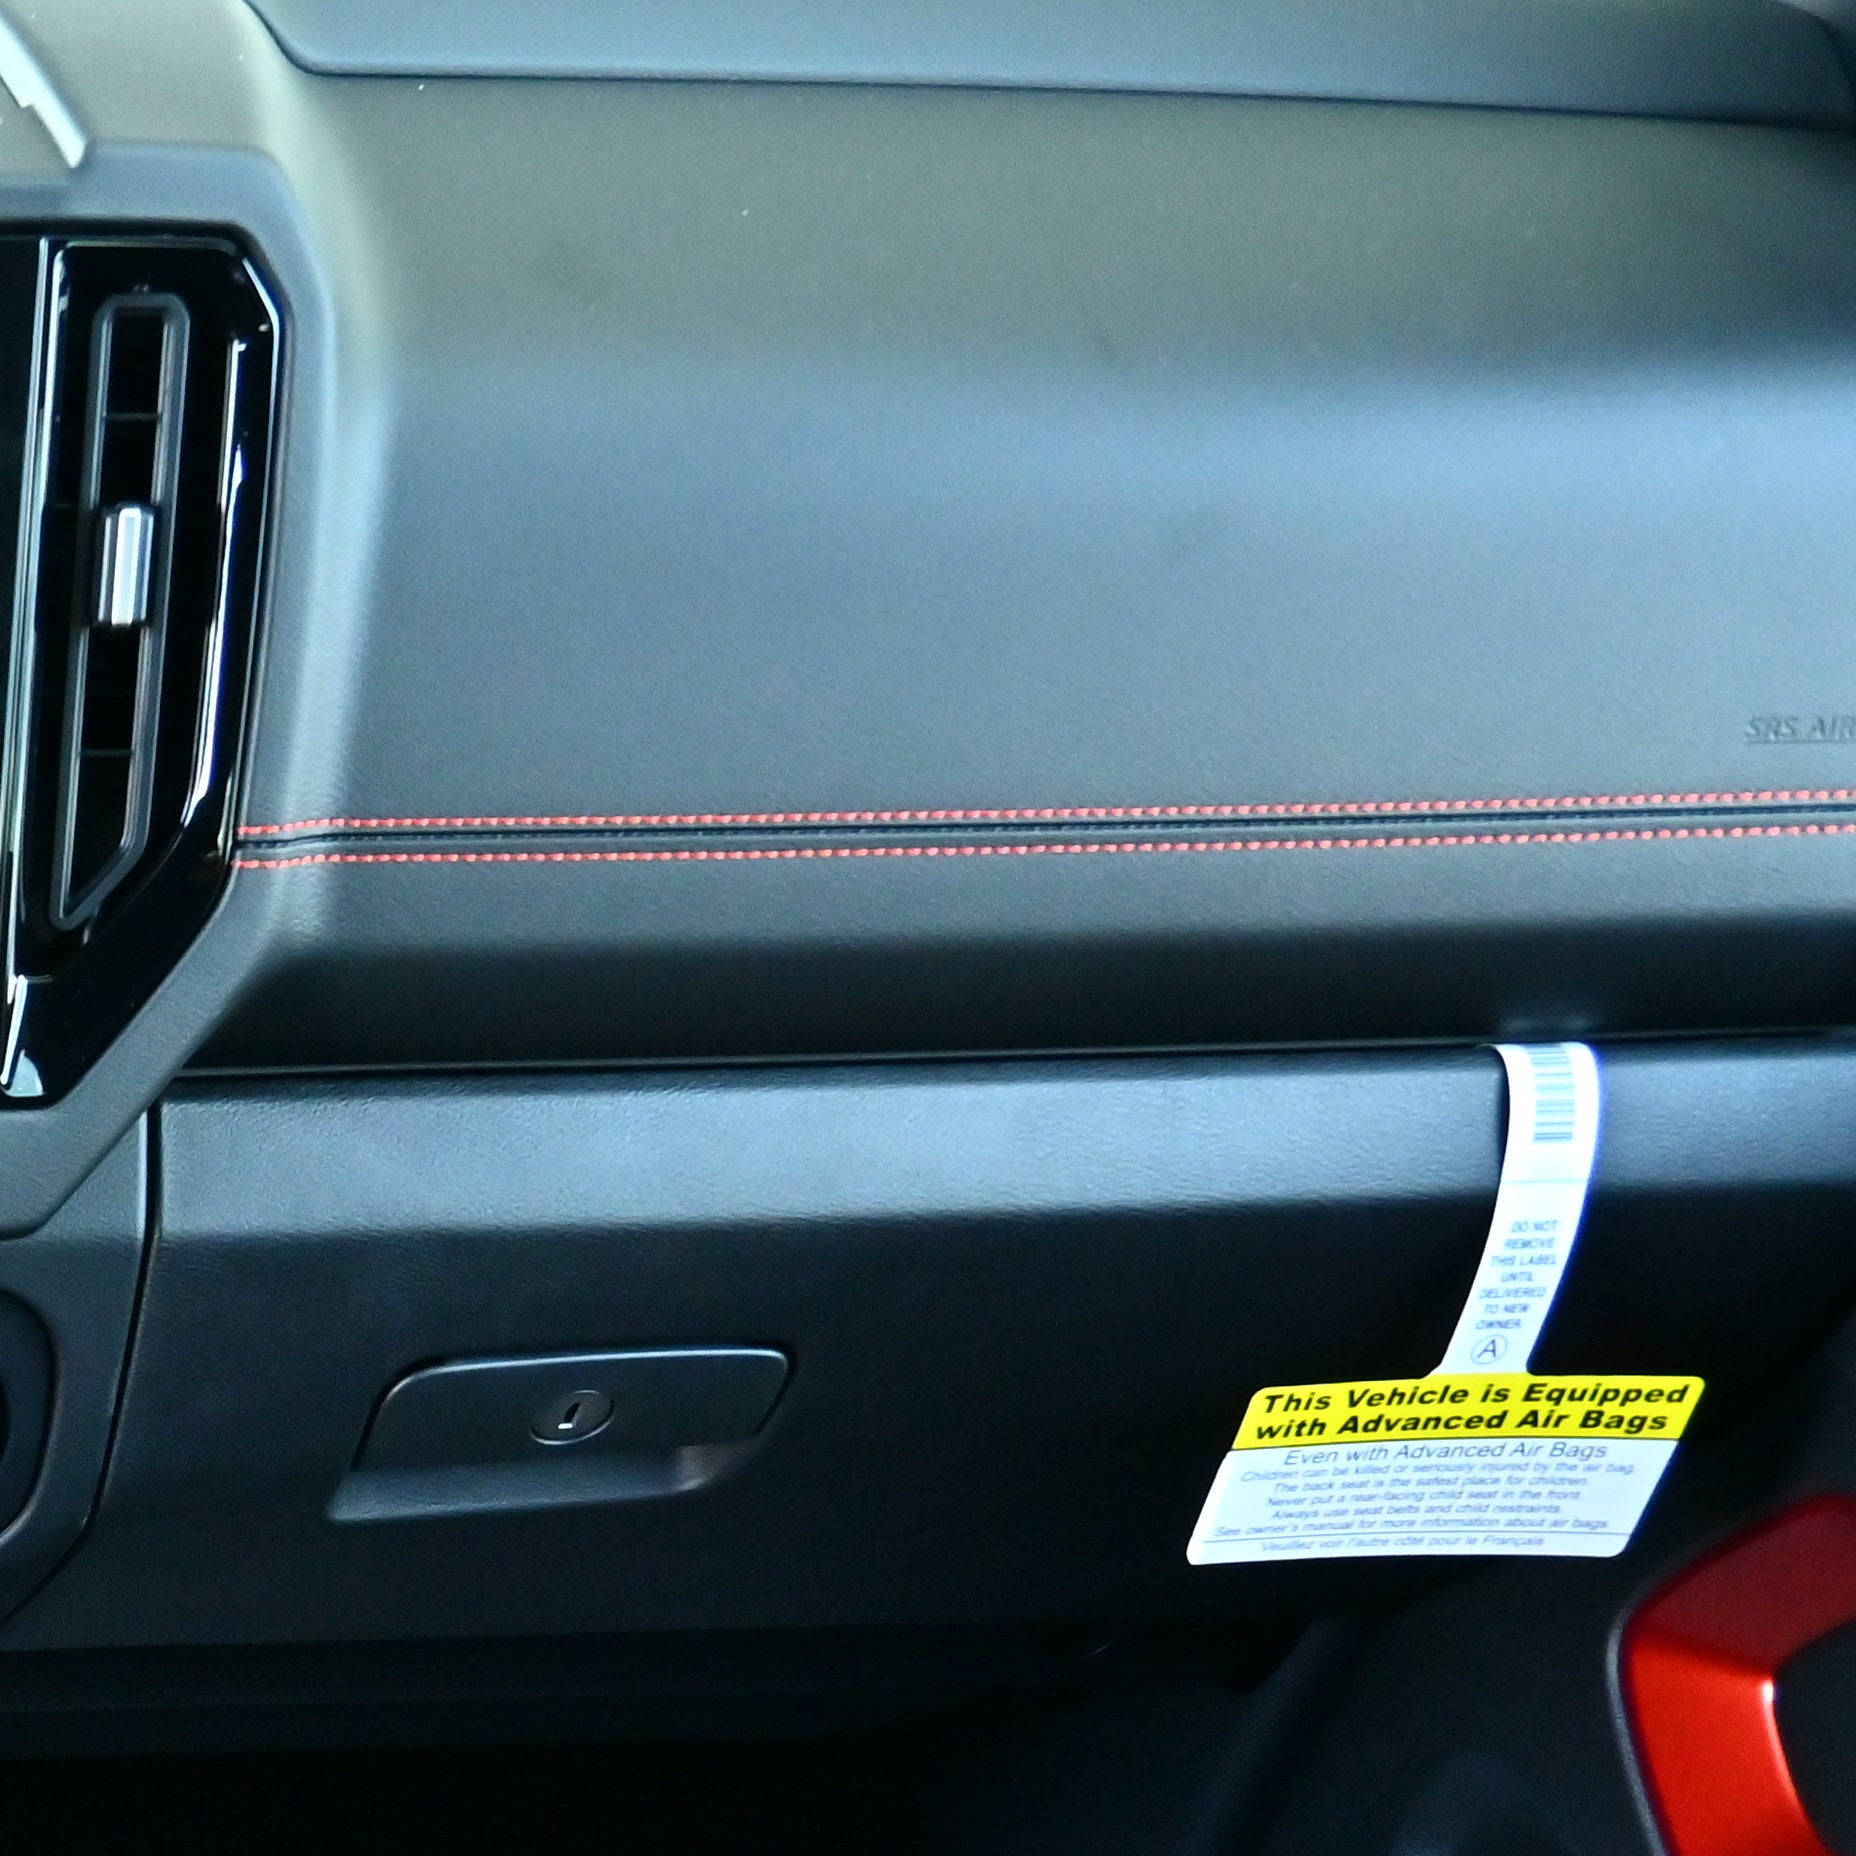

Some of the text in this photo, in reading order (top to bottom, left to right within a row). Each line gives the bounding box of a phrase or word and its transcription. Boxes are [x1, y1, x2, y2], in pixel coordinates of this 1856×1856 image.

[1477, 1339, 1497, 1359] A
[1263, 1383, 1689, 1414] This Vehicle is Equipped
[1256, 1410, 1668, 1441] with Advanced Air Bags
[1284, 1441, 1607, 1466] Even with Advanced Air Bags
